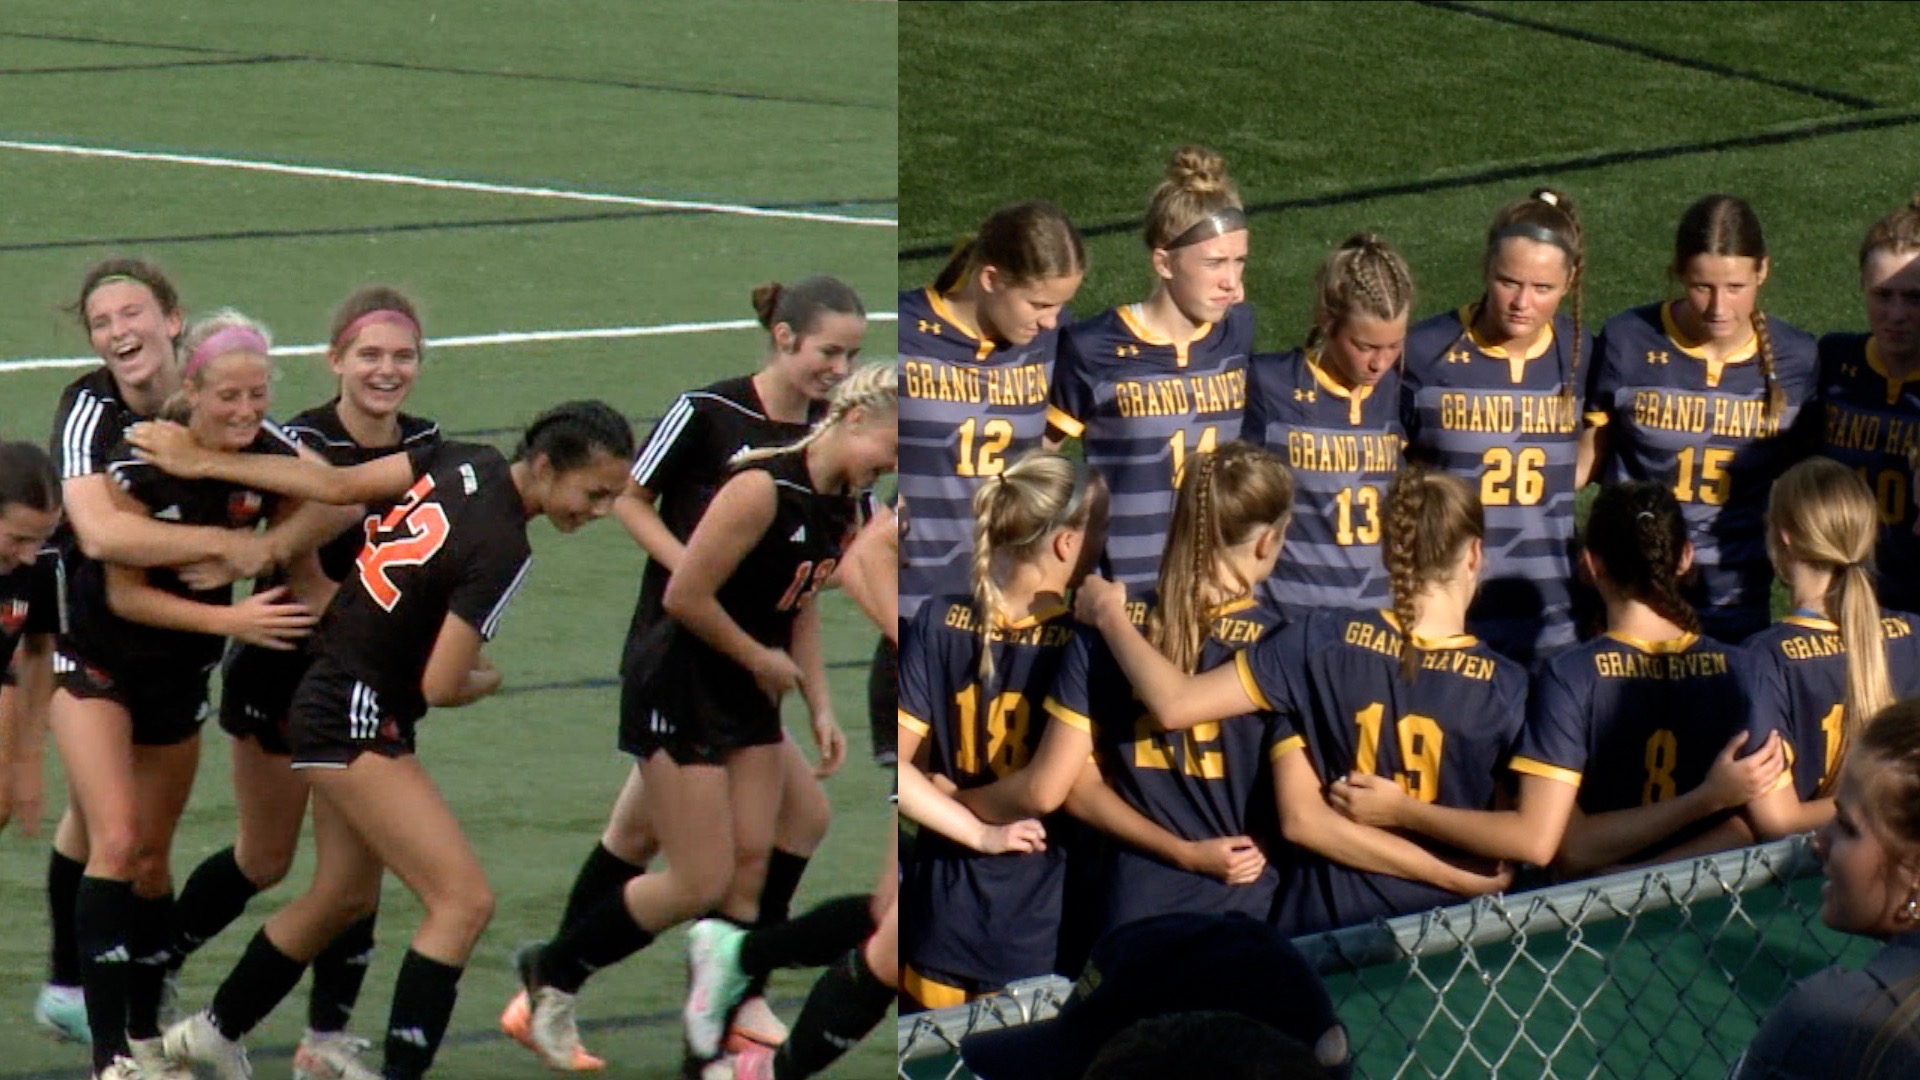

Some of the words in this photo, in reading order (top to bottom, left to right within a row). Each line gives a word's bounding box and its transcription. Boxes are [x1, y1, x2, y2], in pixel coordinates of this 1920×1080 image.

[905, 361, 981, 404] GRAND
[986, 363, 1048, 406] HAVEN
[1115, 378, 1189, 418] GRAND
[1441, 393, 1514, 434] GRAND
[1634, 391, 1706, 434] GRAND
[1824, 402, 1881, 453] RAND
[956, 416, 1014, 477] 12
[1287, 430, 1358, 472] GRAND
[1480, 446, 1547, 506] 26
[1674, 444, 1735, 506] 15
[1335, 484, 1381, 545] 13
[1218, 617, 1264, 644] VEN
[1345, 621, 1404, 659] GRAN
[1422, 651, 1497, 681] HAVEN
[1781, 634, 1846, 660] GRAN
[1595, 651, 1664, 680] GRAND
[955, 683, 1031, 778] 18
[1355, 702, 1443, 804] 19
[1642, 728, 1678, 802] 8
